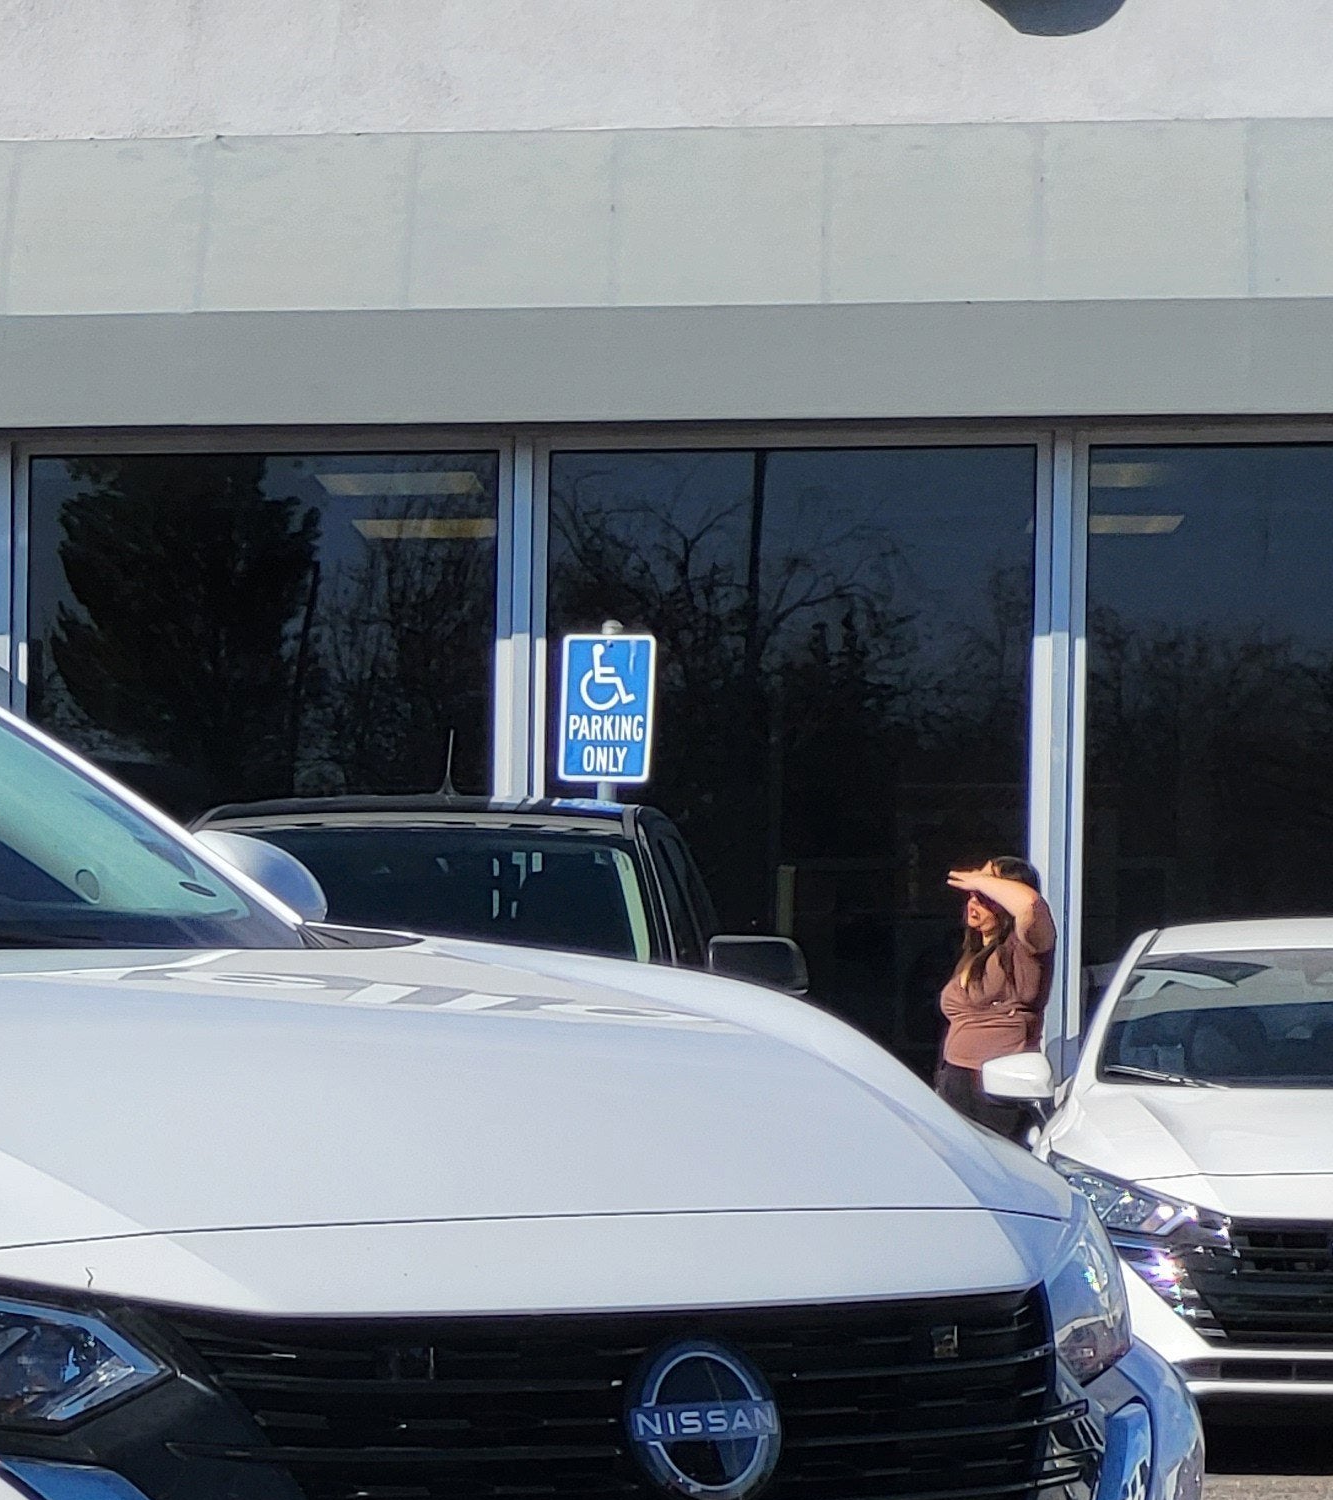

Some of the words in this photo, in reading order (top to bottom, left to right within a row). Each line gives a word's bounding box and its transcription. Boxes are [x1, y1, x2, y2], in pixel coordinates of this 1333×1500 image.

[569, 714, 644, 742] PARKING
[583, 745, 628, 773] ONLY
[635, 1407, 773, 1436] NISSAN
